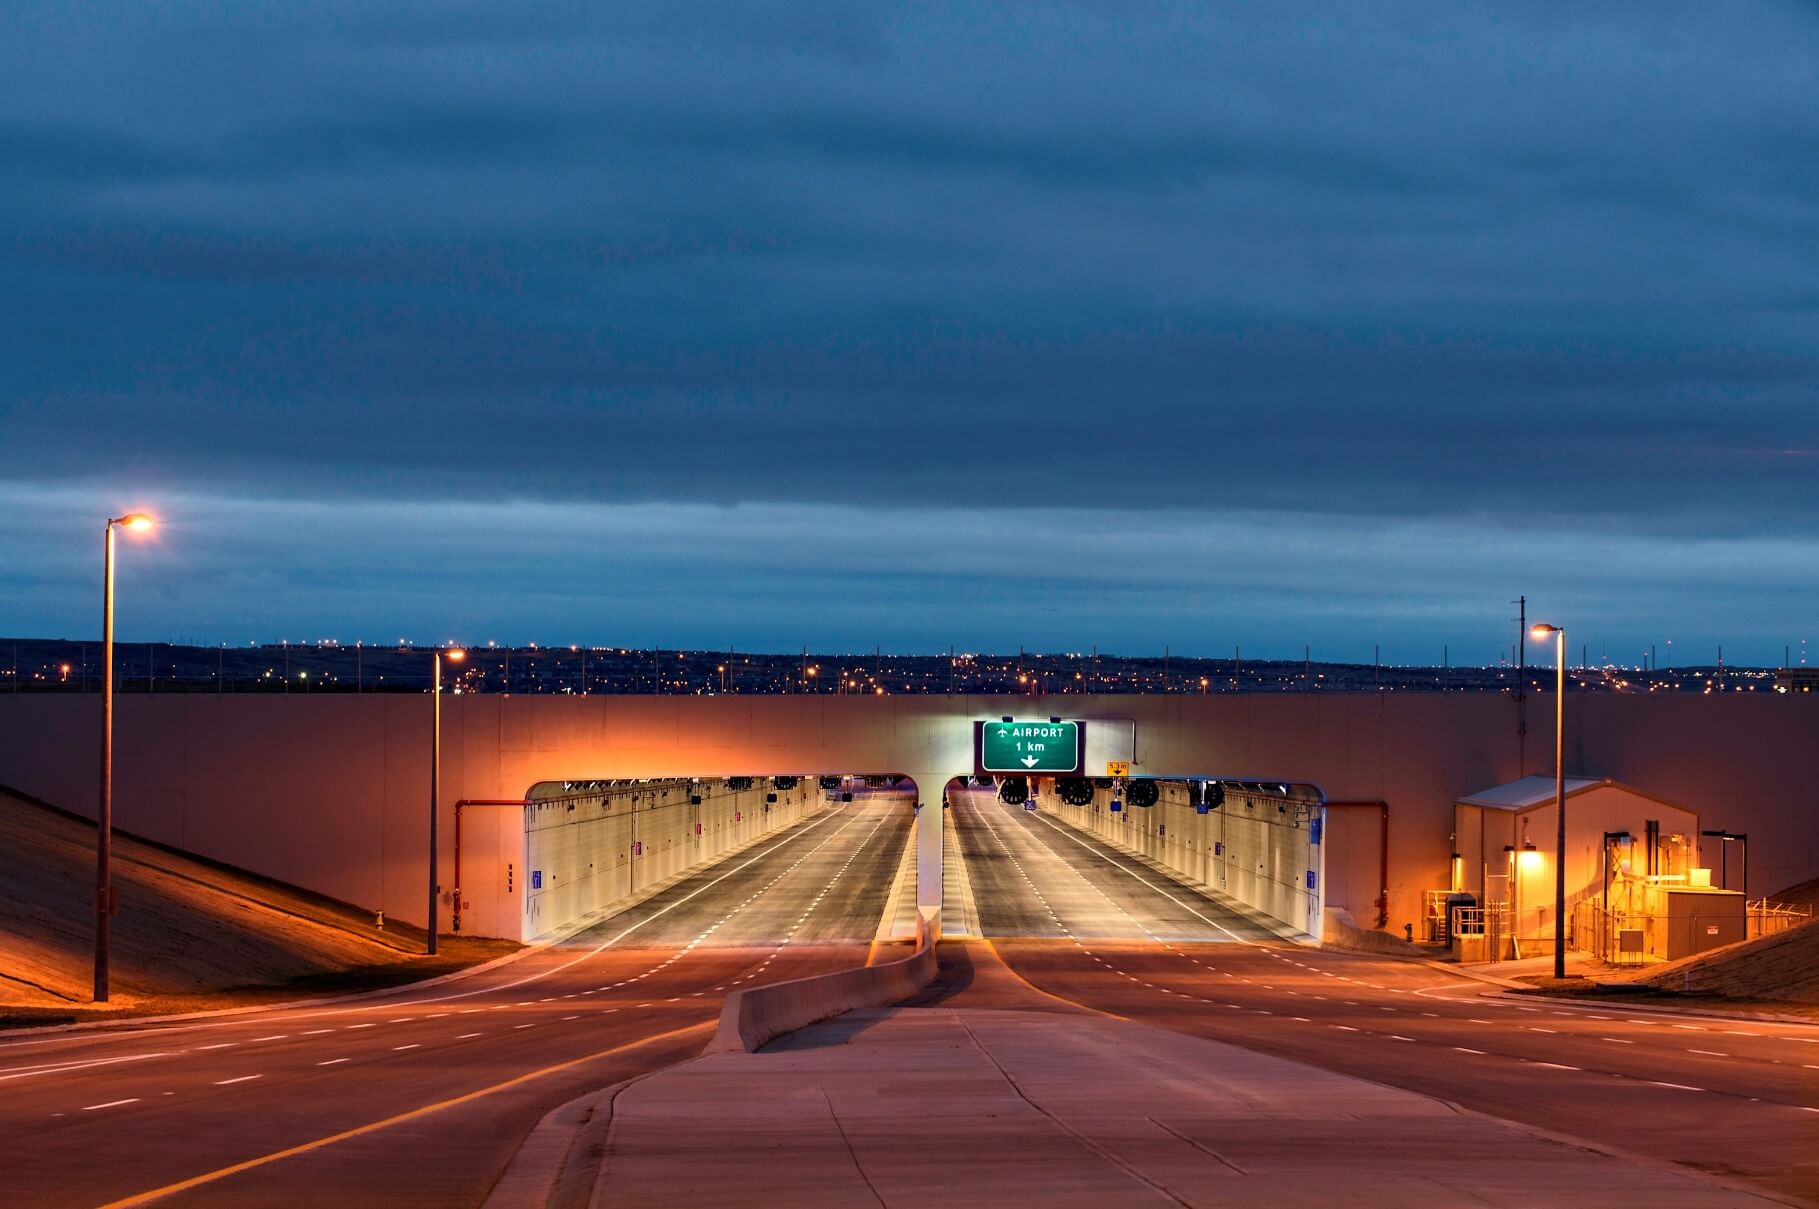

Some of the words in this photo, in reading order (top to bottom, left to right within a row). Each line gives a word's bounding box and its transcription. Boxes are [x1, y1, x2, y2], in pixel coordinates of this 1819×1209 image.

[1012, 727, 1064, 738] AIRPORT
[1016, 742, 1021, 752] 1
[1027, 742, 1045, 752] km
